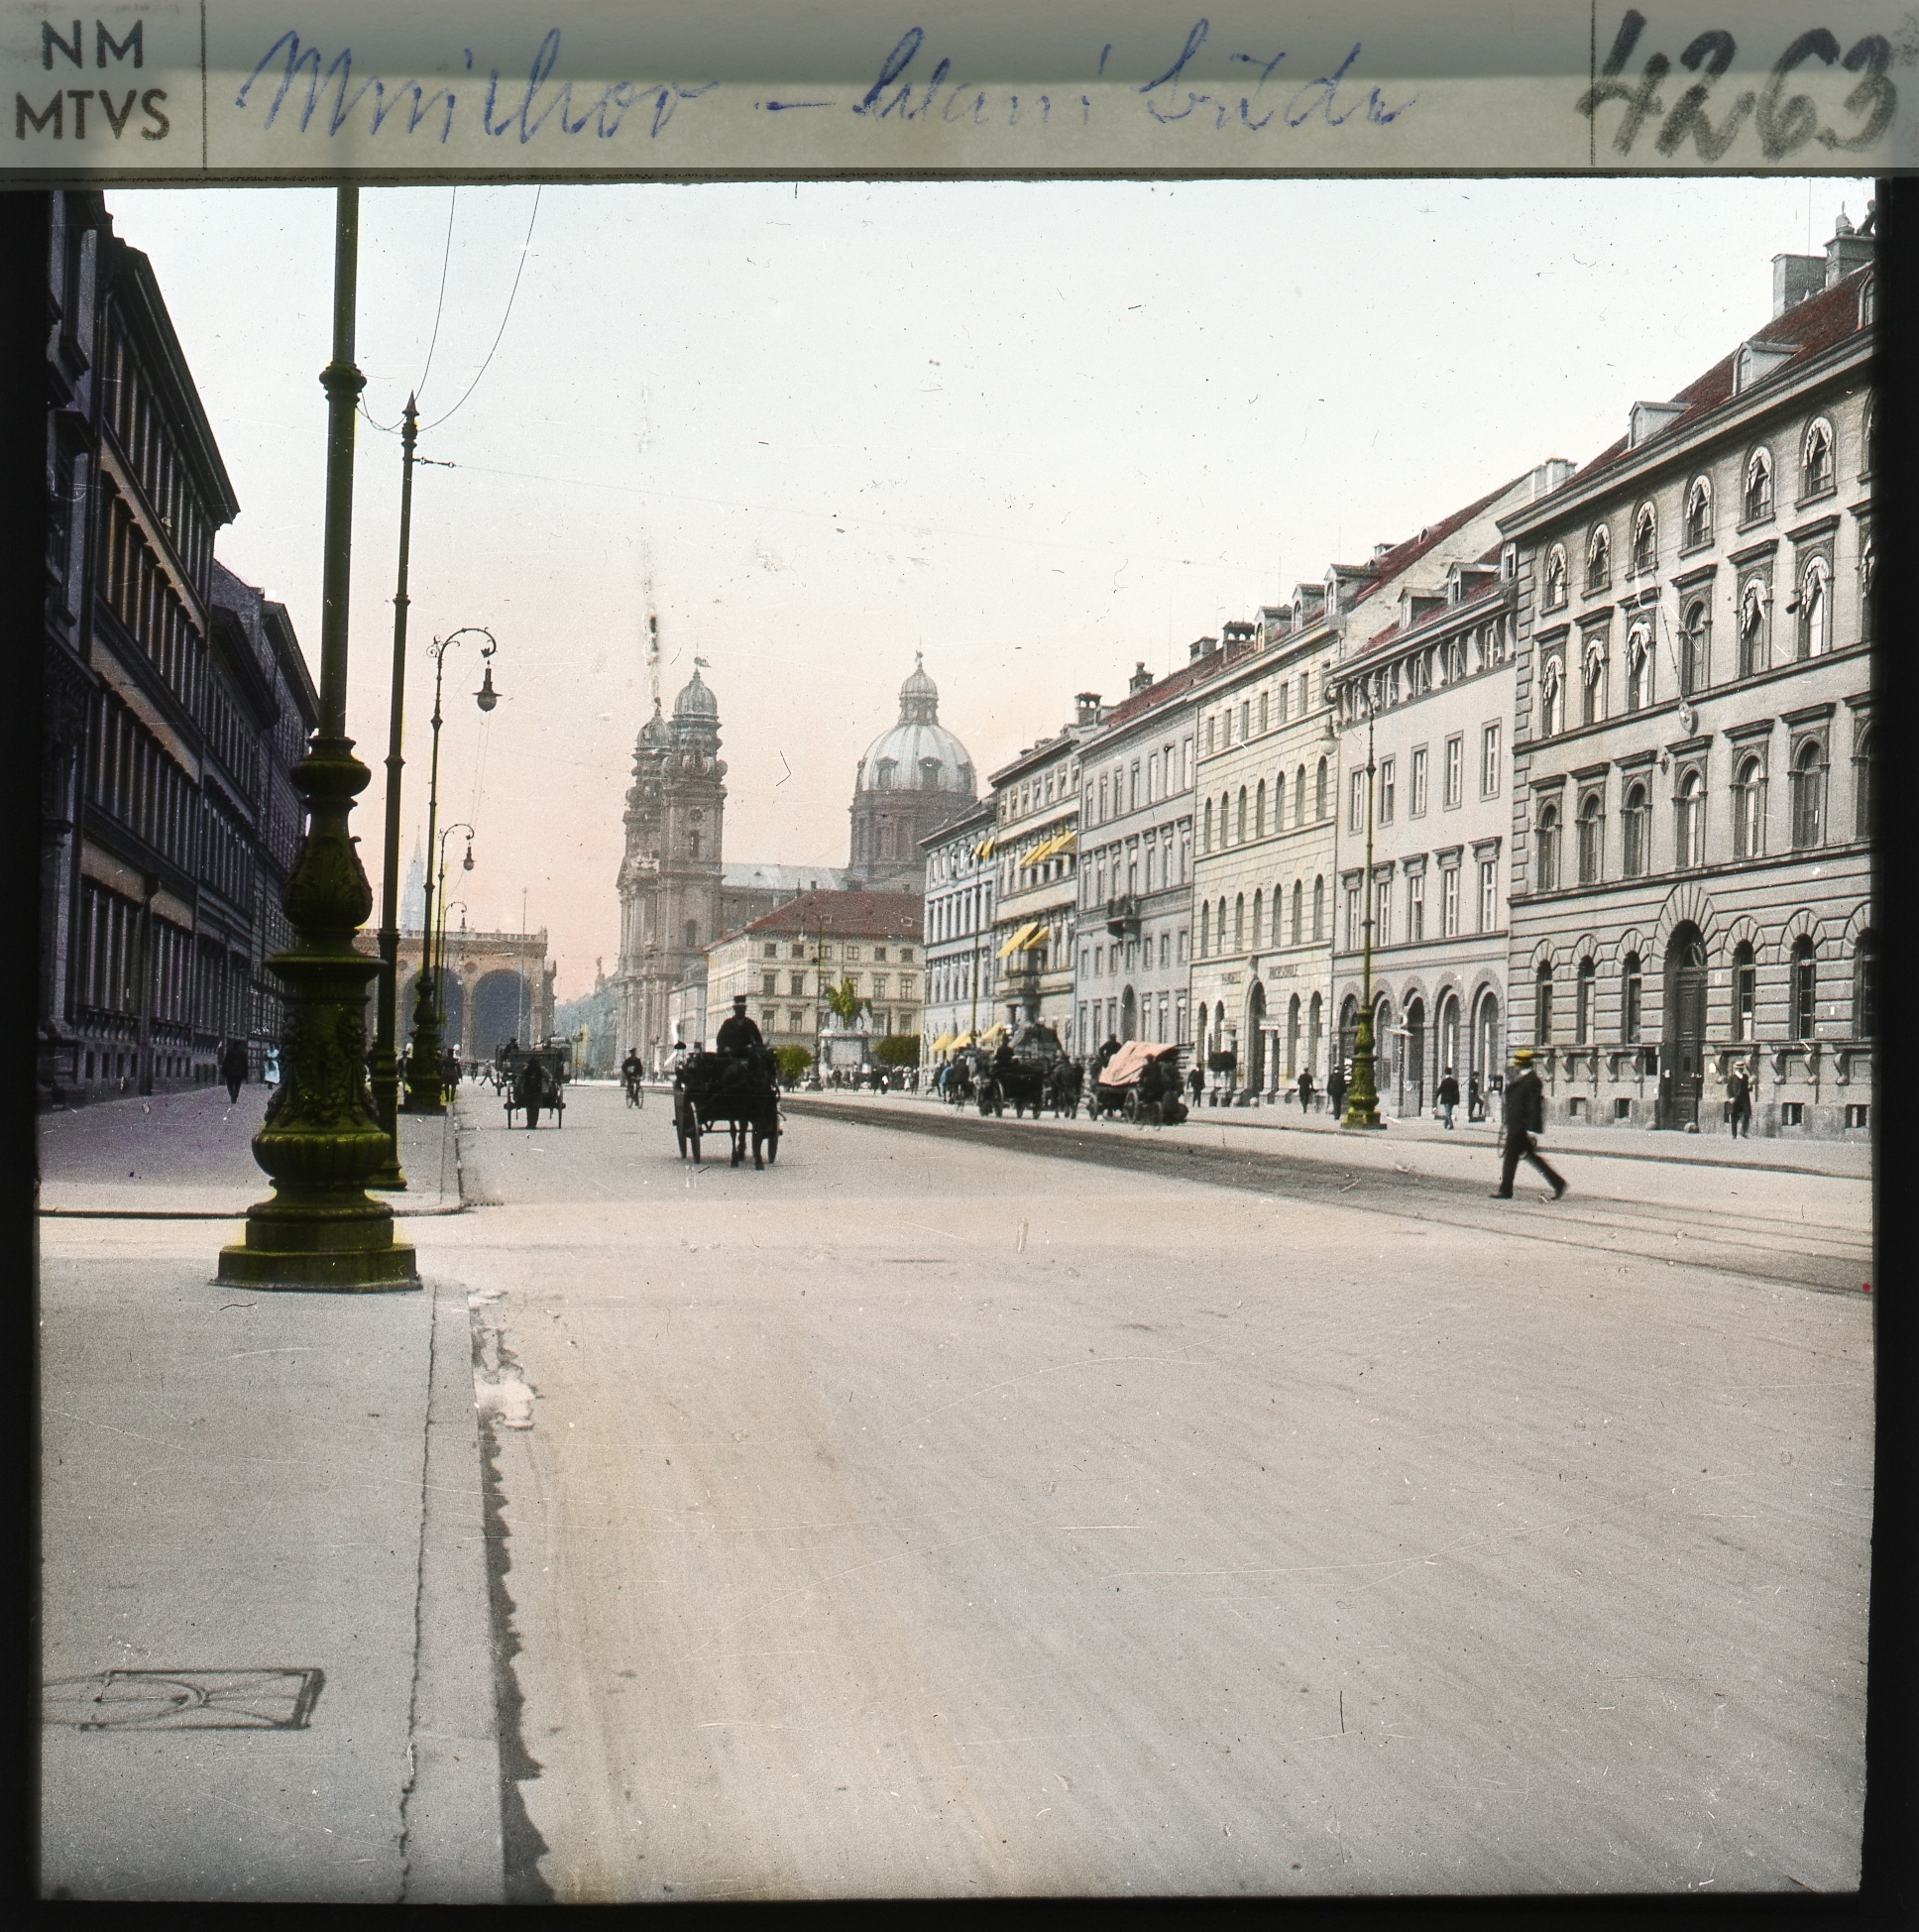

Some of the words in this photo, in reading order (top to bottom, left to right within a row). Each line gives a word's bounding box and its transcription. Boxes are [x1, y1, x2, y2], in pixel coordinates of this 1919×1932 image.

[42, 19, 144, 69] NM
[1574, 9, 1897, 164] 4263
[14, 89, 170, 141] MTVS
